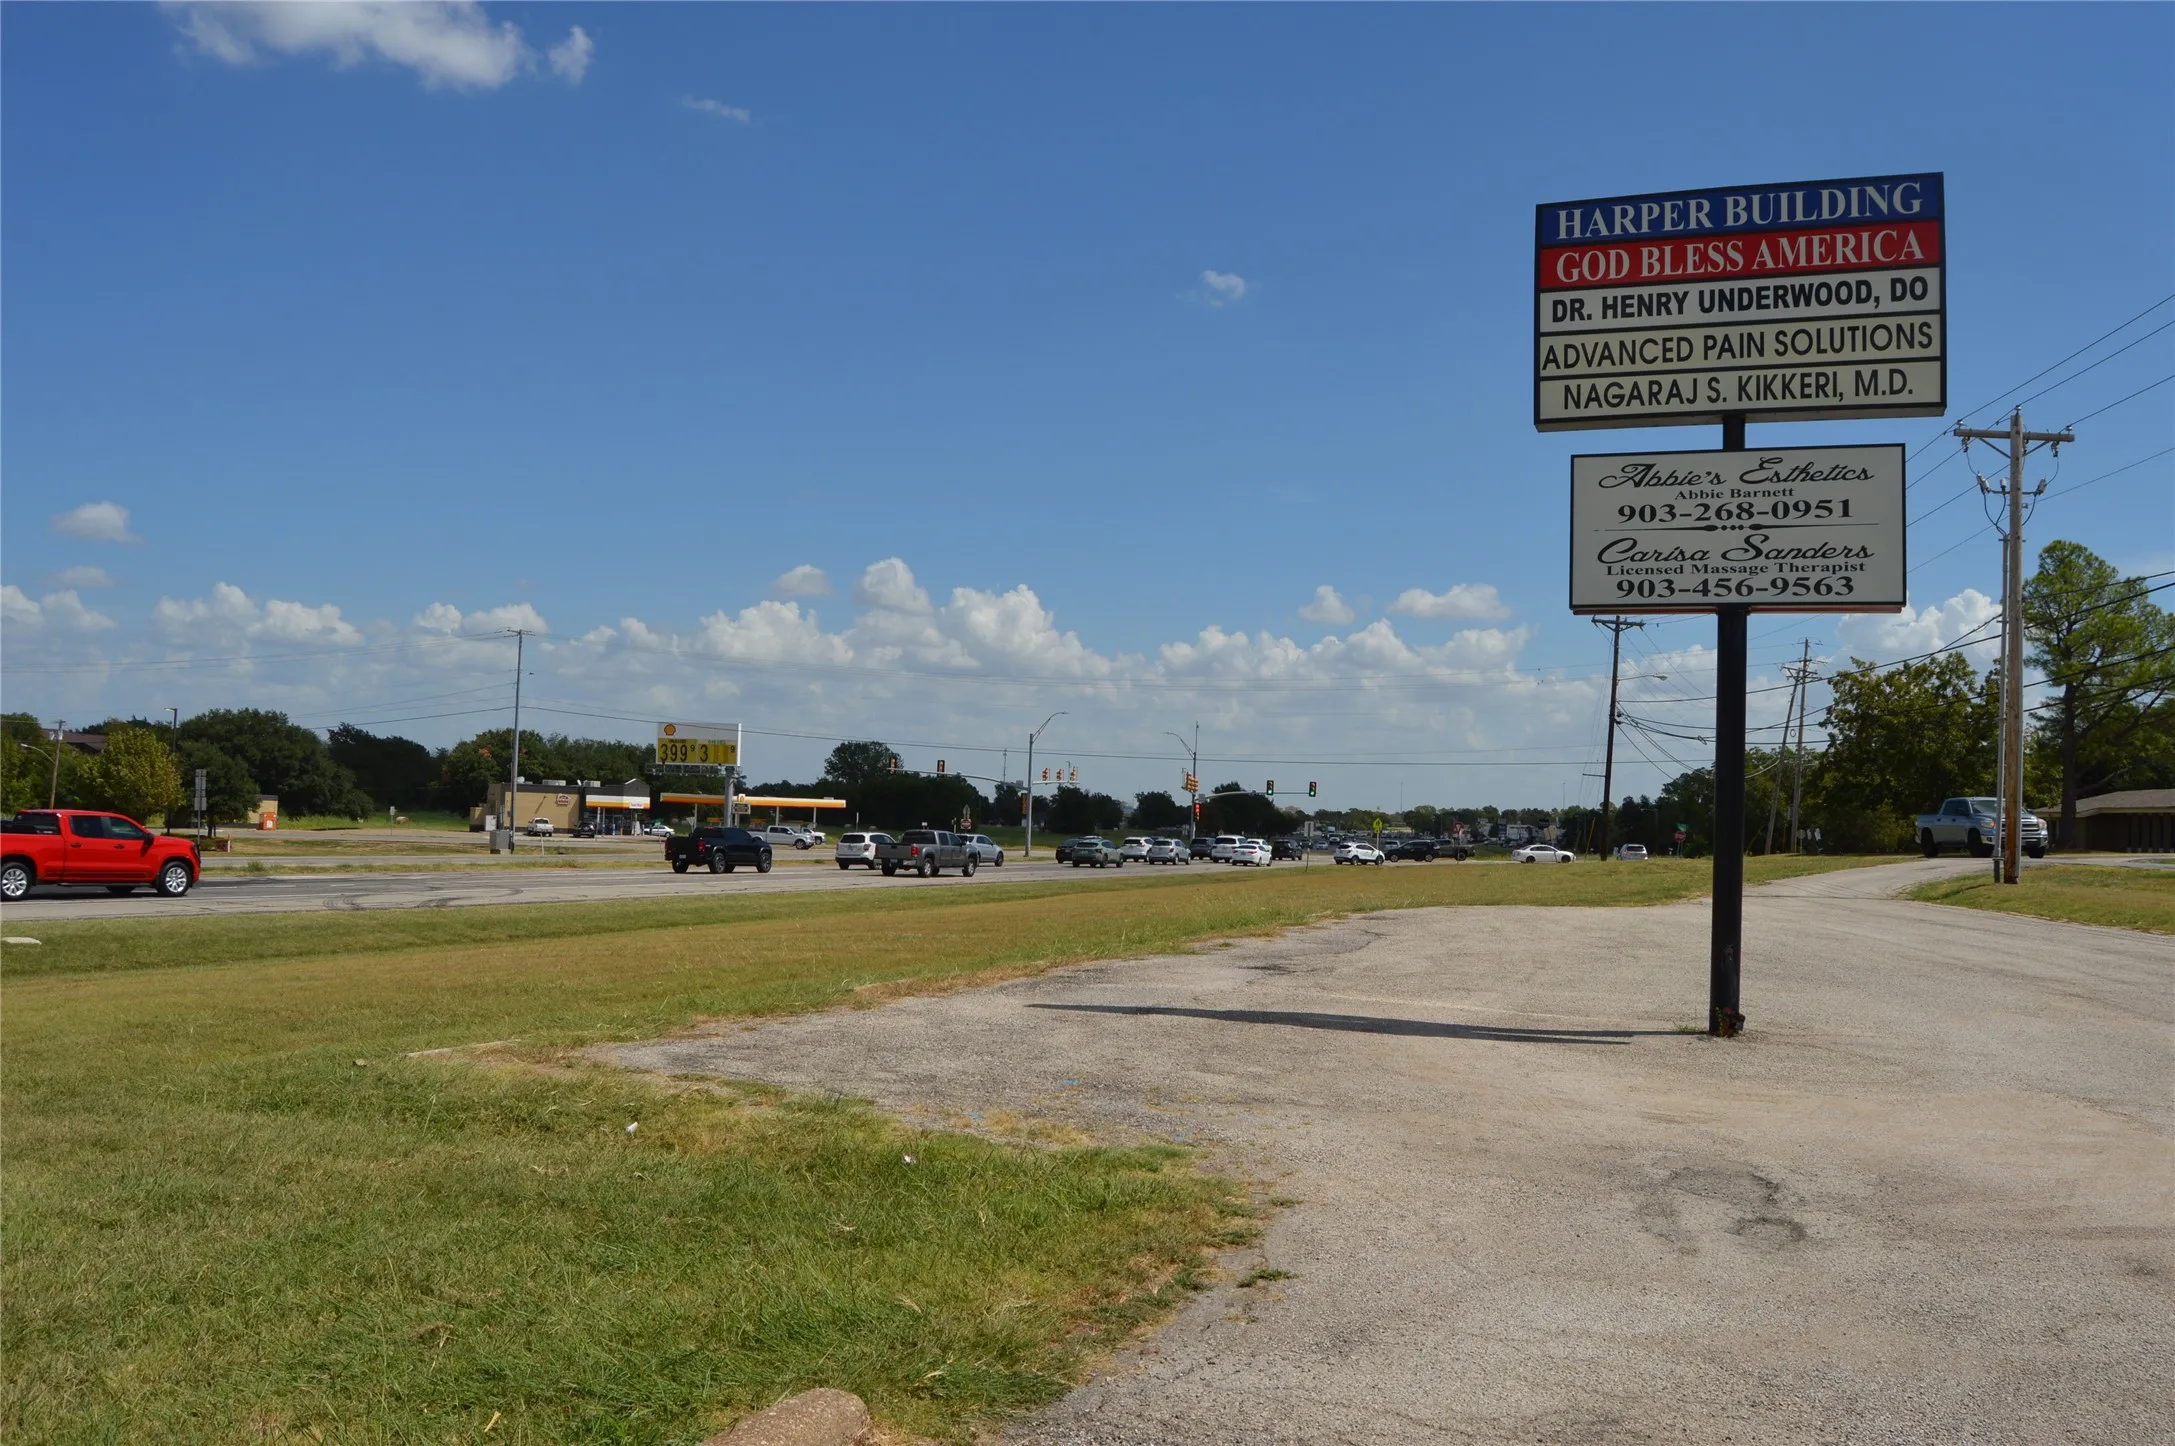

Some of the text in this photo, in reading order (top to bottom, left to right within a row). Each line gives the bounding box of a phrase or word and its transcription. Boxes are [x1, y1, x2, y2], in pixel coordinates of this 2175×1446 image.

[1557, 182, 1922, 239] HARPER BUILDING
[1557, 229, 1924, 283] GOD BLESS AMERICA
[1552, 276, 1928, 323] DR. HENRY UNDERWOOD, DO
[1542, 322, 1932, 370] ADVANCED PAIN SOLUTIONS
[1564, 369, 1913, 410] NAGARAJ S. KIKKERI, M.D.
[1599, 457, 1874, 488] Abbie's Esthetics
[1675, 488, 1794, 500] Abbie Barnett
[1618, 499, 1853, 524] 903-268-0951
[1597, 534, 1874, 564] Carisa Sanders
[1607, 562, 1865, 576] Licensed Massage Therapist
[1616, 576, 1854, 598] 903-456-9563
